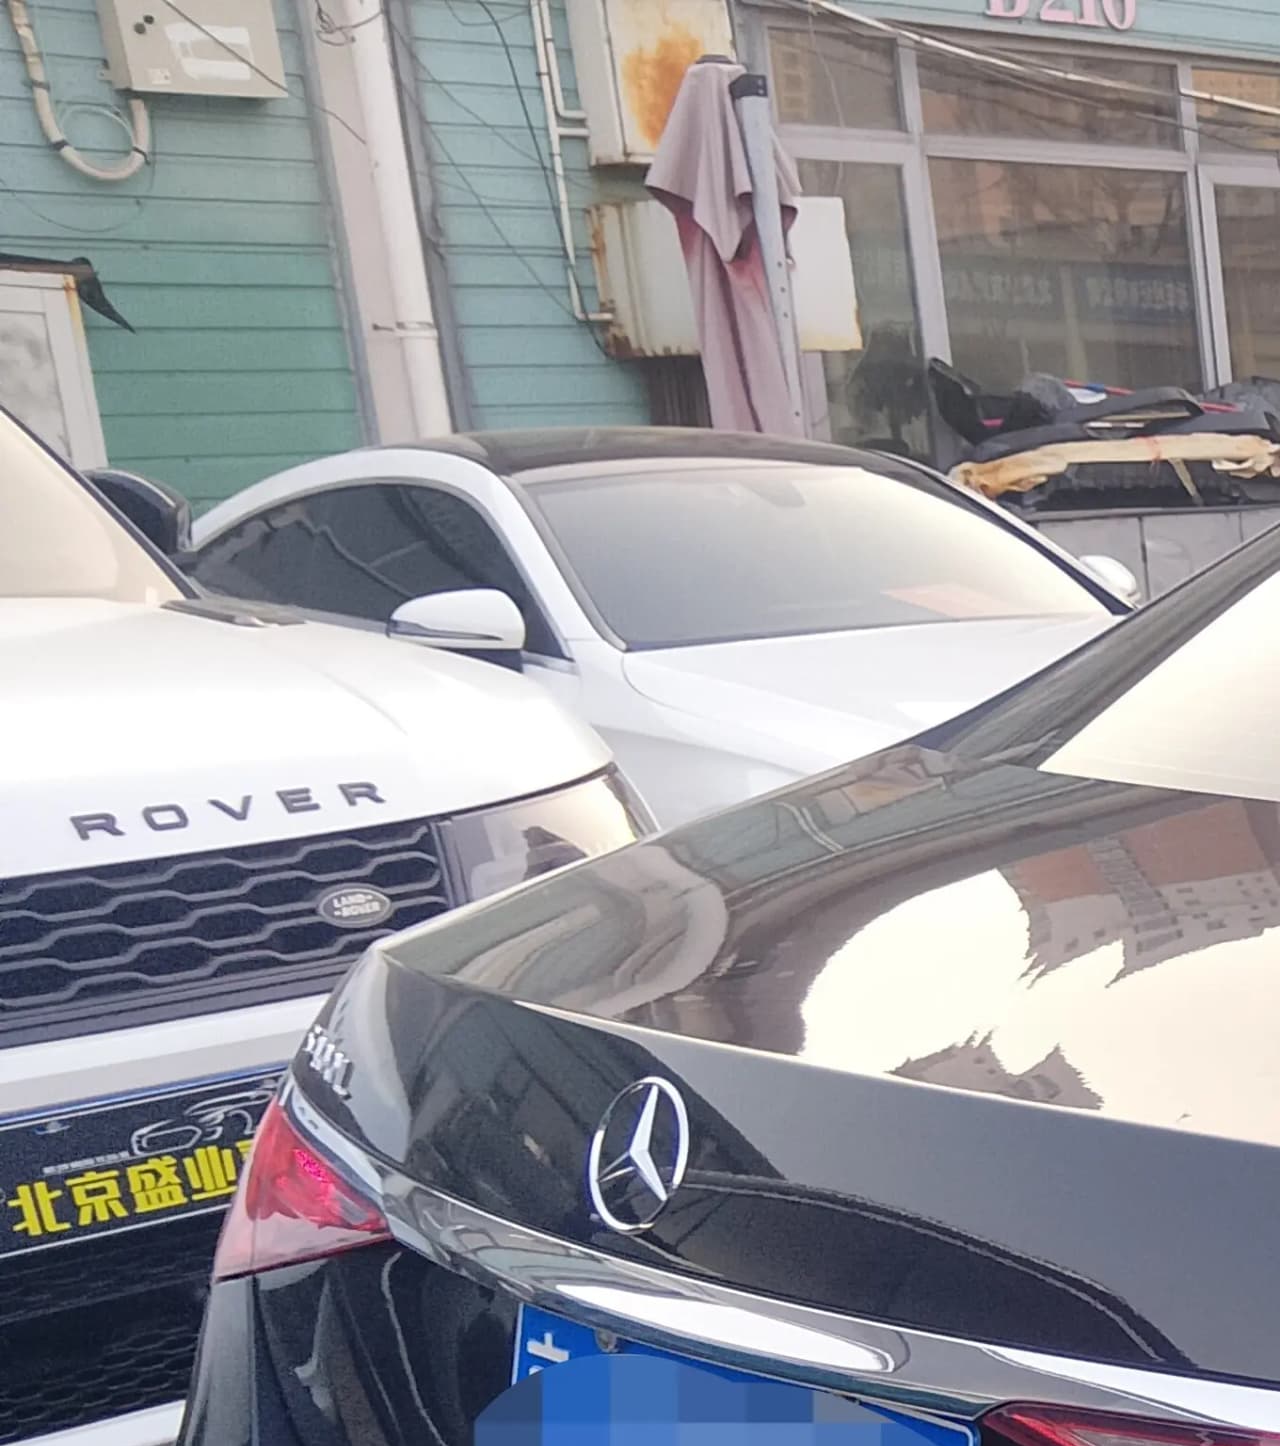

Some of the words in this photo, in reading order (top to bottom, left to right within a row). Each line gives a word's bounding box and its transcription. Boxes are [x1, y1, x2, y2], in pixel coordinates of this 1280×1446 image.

[69, 781, 386, 841] ROVER
[7, 1139, 254, 1236] 北京盛业
